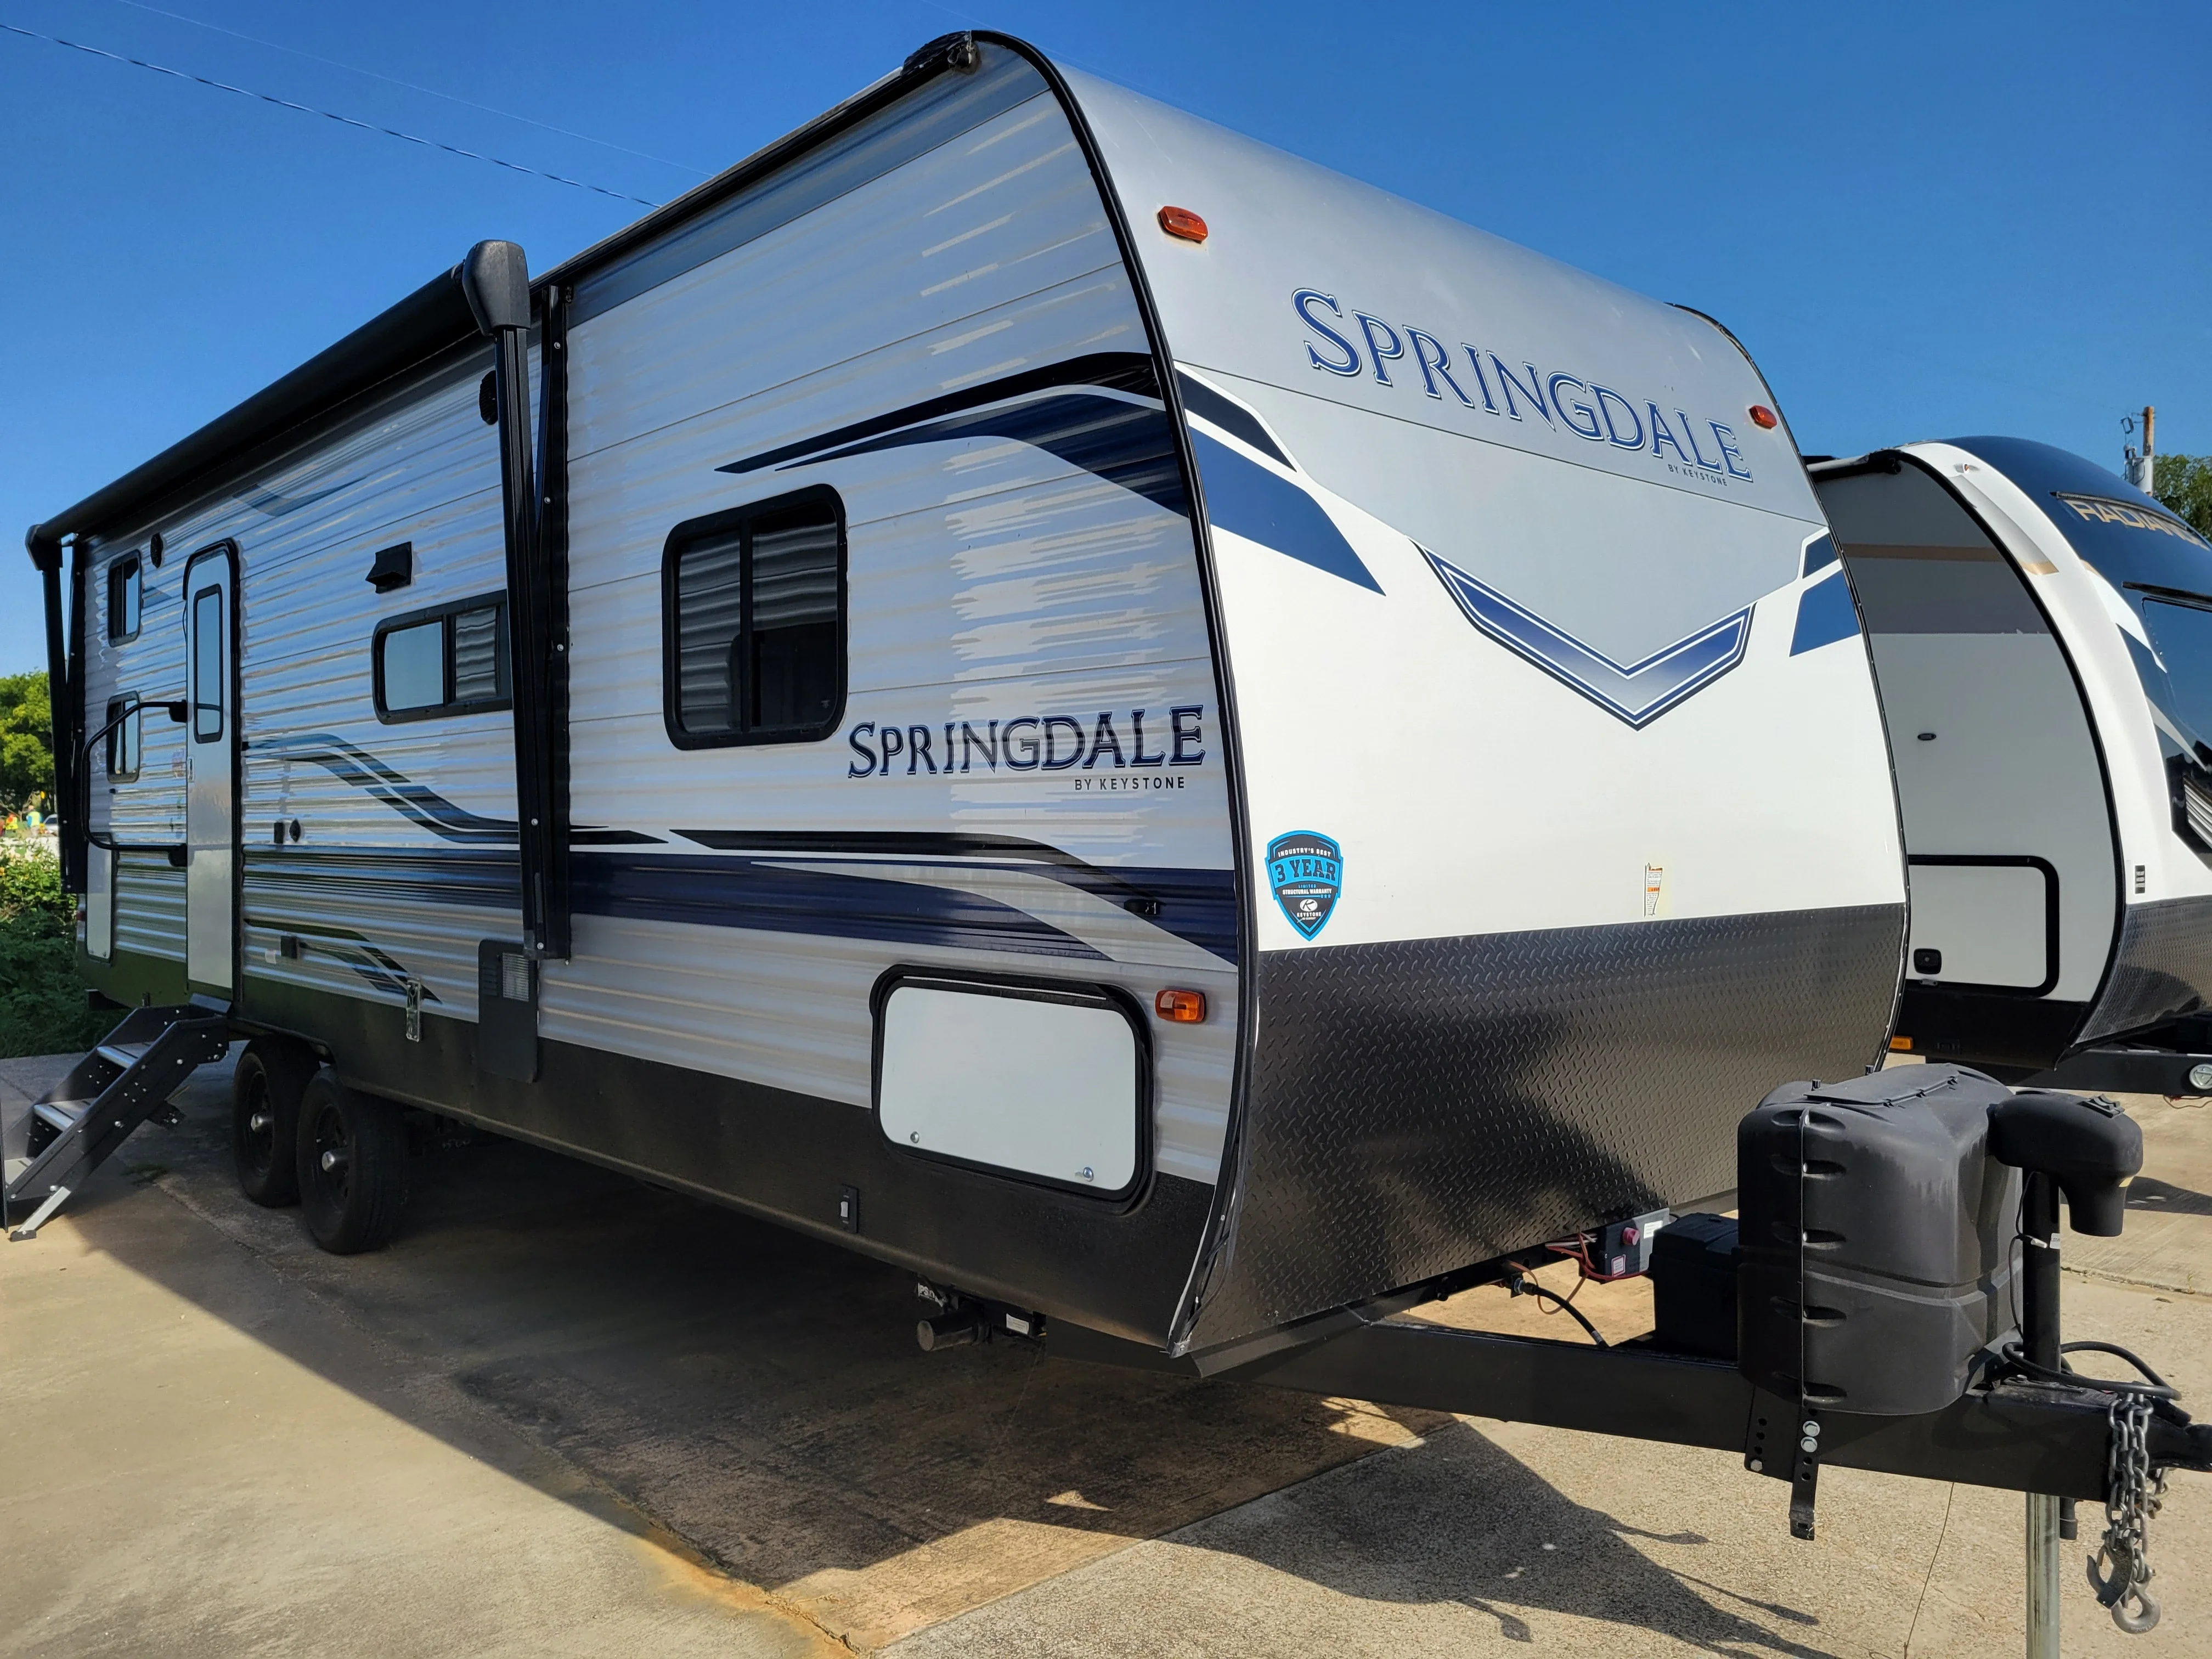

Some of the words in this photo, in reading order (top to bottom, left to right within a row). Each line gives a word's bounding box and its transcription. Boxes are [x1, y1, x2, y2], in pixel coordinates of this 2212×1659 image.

[1291, 287, 1753, 483] SPRINGDALE
[1668, 464, 1679, 473] BY
[1682, 467, 1728, 487] KEYSTONE
[848, 704, 1205, 778] SPRINGDALE
[1074, 779, 1092, 791] BY
[1099, 777, 1184, 790] KEYSTONE
[1278, 847, 1314, 857] INDUSTRY'S
[1316, 848, 1331, 857] BEST
[1275, 864, 1286, 883] 3
[1289, 859, 1336, 882] YEAR
